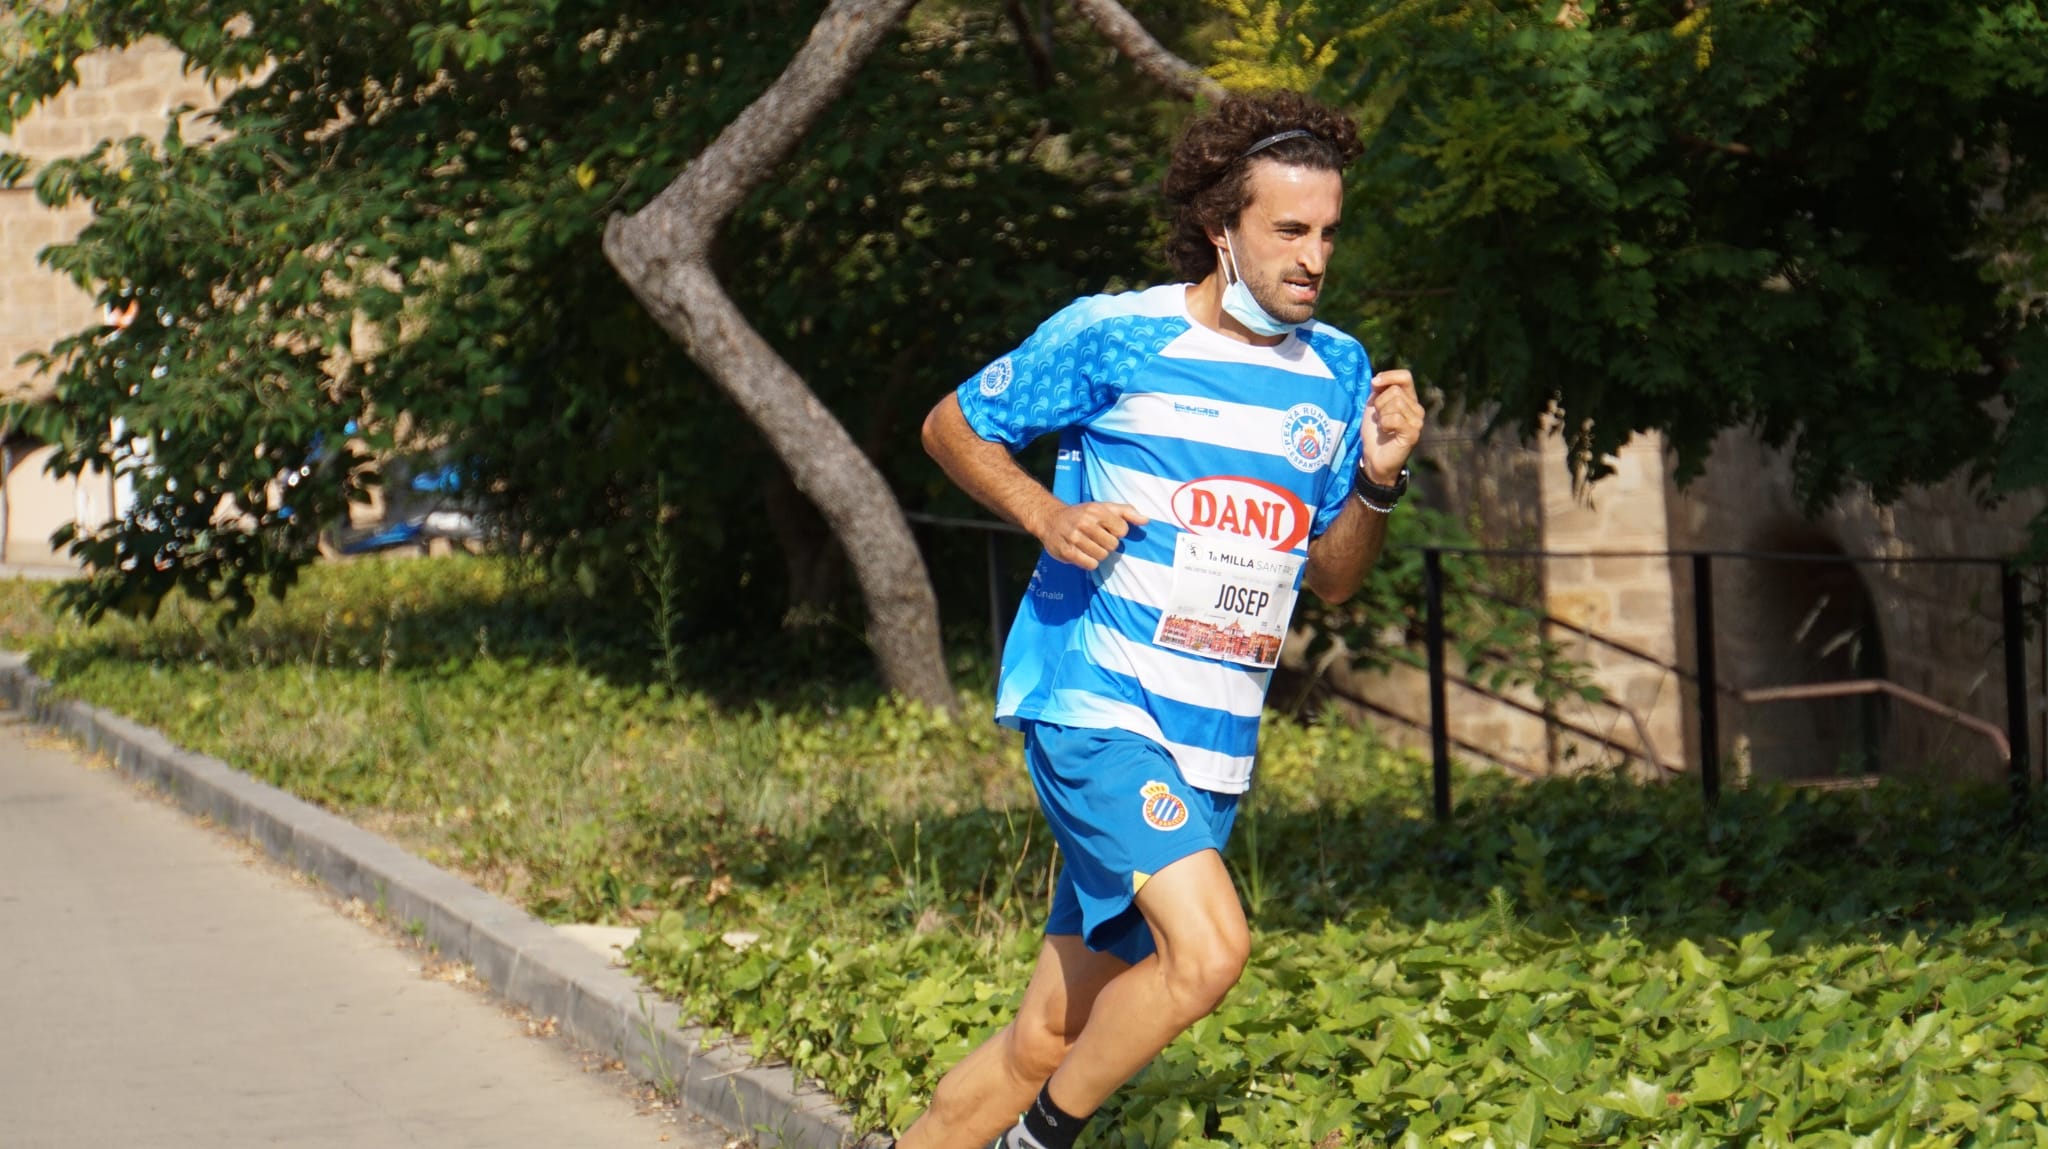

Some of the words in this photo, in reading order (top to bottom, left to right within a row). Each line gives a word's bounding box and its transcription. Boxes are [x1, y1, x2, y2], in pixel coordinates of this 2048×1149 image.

[1283, 410, 1300, 445] PENYA
[1191, 488, 1285, 541] DANI
[1220, 553, 1254, 570] MILLA
[1214, 583, 1270, 617] JOSEP
